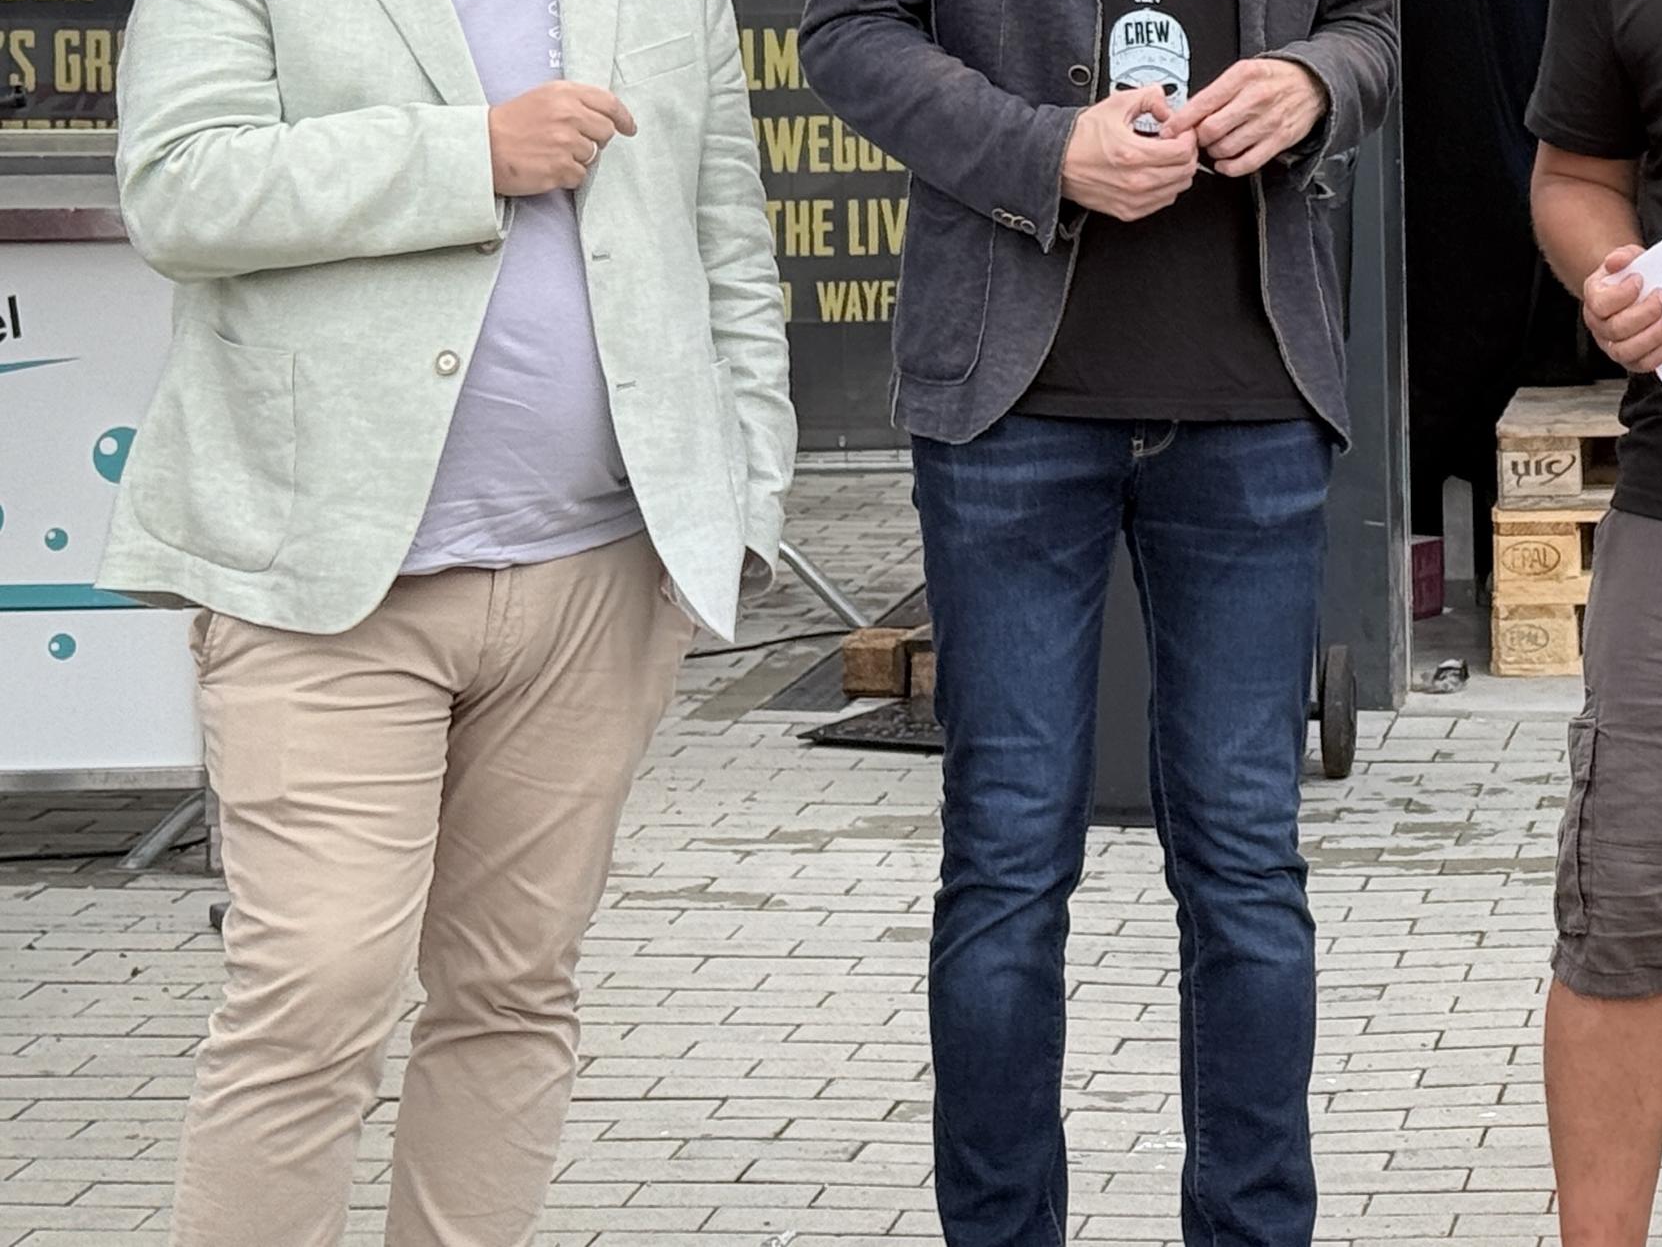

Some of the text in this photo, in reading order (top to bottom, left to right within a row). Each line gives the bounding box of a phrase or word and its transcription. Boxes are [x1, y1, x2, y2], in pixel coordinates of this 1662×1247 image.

[1124, 21, 1170, 45] CREW
[766, 199, 834, 257] THE
[1511, 547, 1550, 570] EPAL
